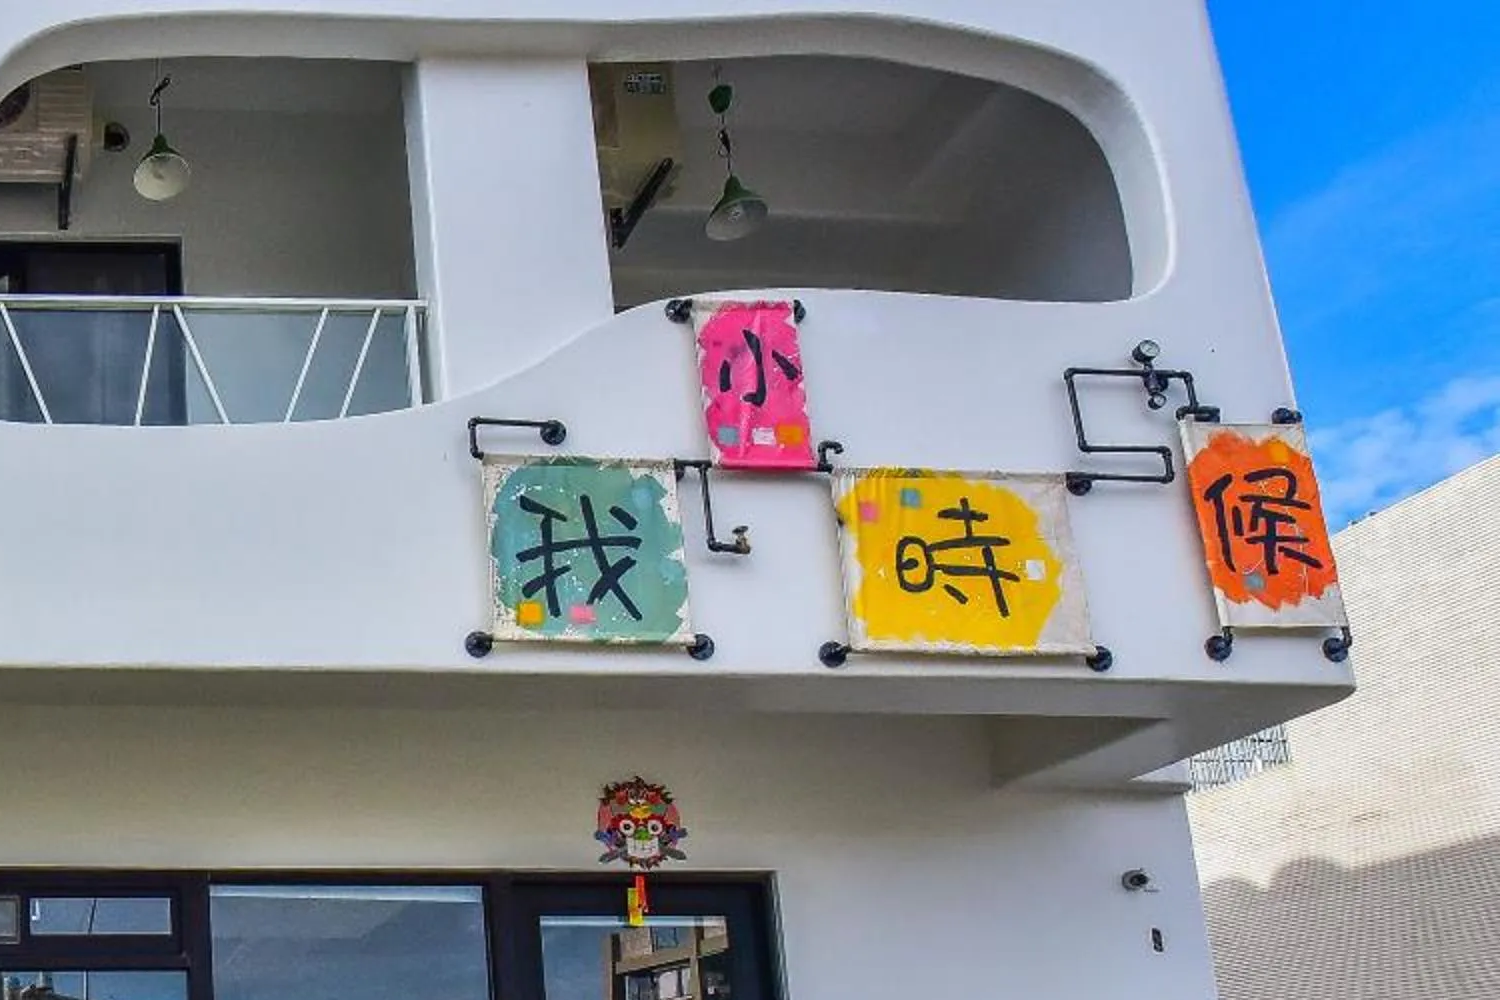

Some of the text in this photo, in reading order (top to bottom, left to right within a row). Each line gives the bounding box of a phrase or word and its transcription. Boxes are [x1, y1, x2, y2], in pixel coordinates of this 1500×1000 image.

[515, 329, 1324, 621] 我 小 時 候
